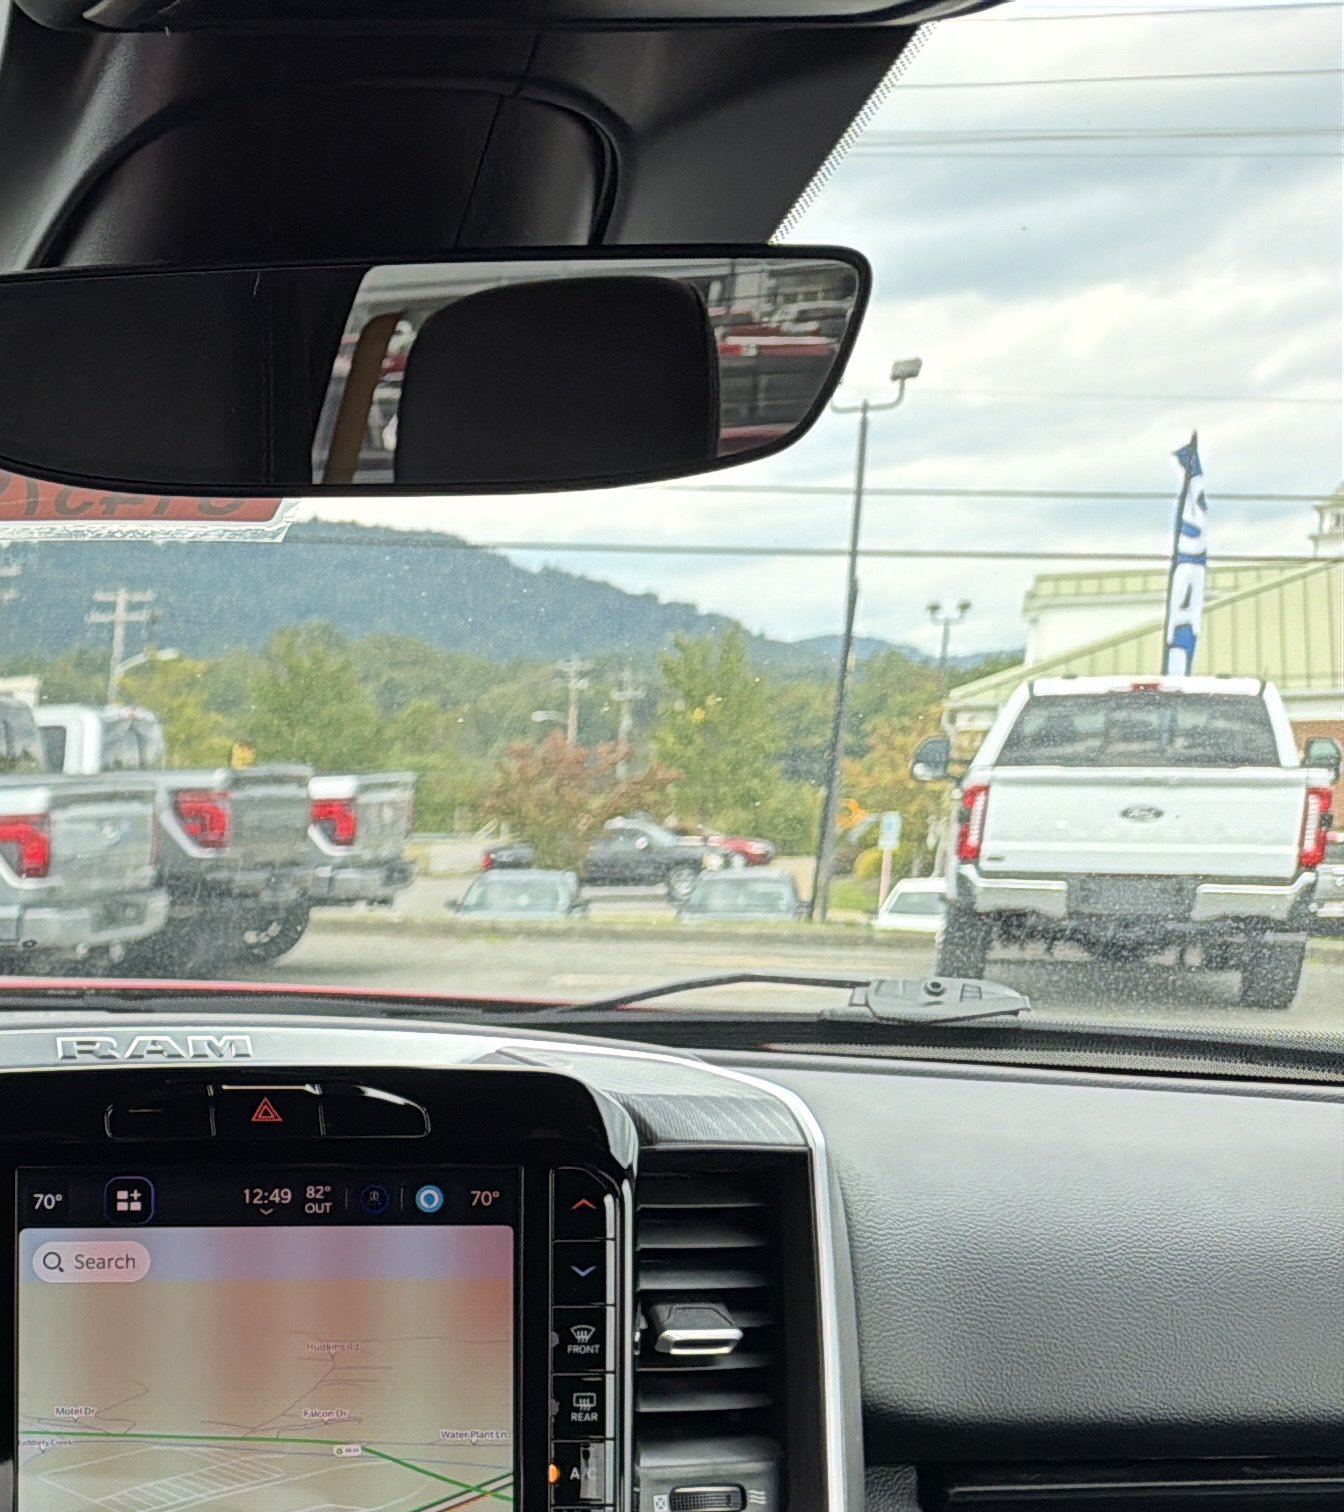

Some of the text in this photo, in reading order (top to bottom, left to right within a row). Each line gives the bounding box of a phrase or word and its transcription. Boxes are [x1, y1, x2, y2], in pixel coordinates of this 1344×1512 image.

[56, 1035, 254, 1060] RAM
[243, 1188, 292, 1204] 12:49
[305, 1185, 332, 1200] 82°
[470, 1190, 500, 1207] 70°
[33, 1193, 63, 1210] 70°
[304, 1202, 333, 1214] OUT
[74, 1254, 136, 1270] Search
[567, 1344, 600, 1355] FRONT
[55, 1407, 83, 1416] Motel
[570, 1412, 599, 1422] REAR
[569, 1467, 597, 1481] A/C
